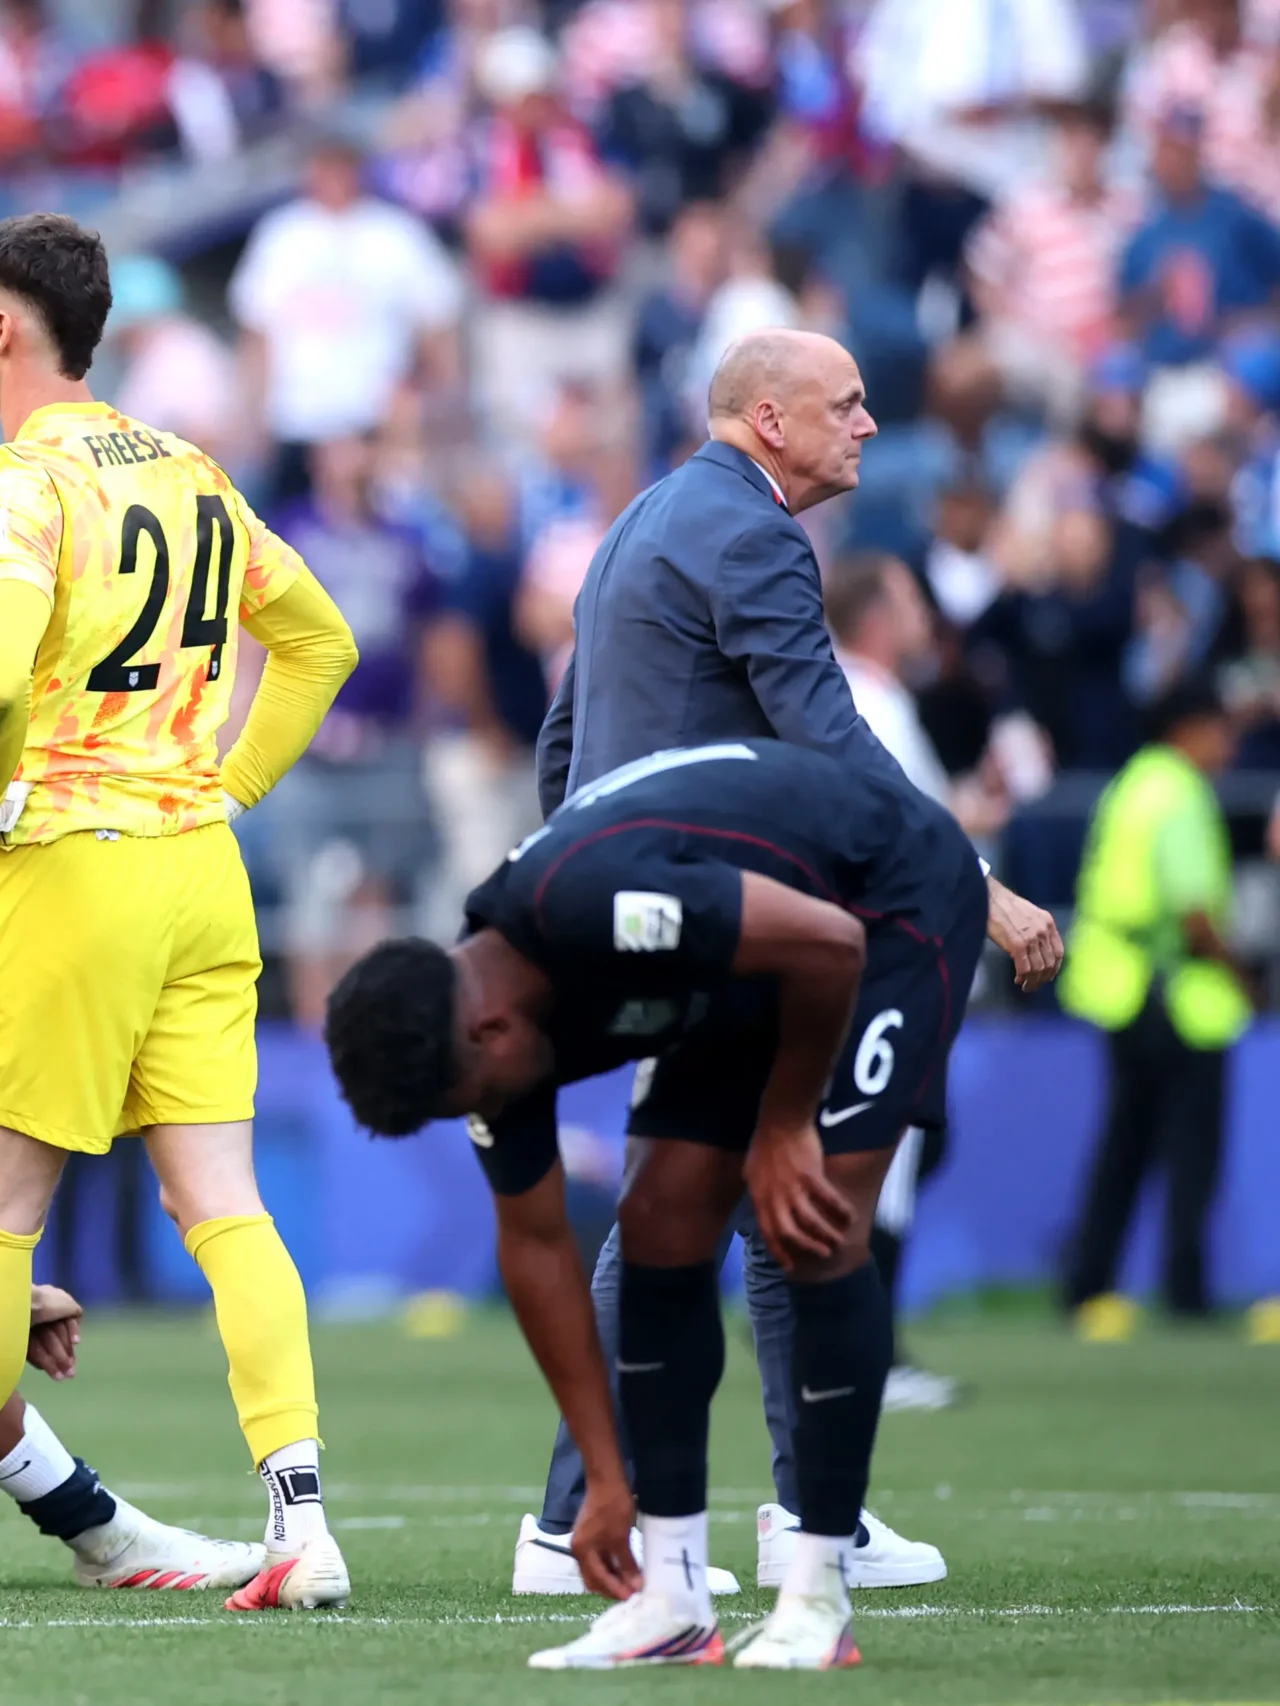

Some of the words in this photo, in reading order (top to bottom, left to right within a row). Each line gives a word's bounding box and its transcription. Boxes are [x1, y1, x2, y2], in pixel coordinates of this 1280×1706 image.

[82, 430, 172, 468] FREESE
[85, 494, 235, 692] 24
[853, 1007, 904, 1096] 6
[266, 1474, 286, 1542] TAPEDESIGN
